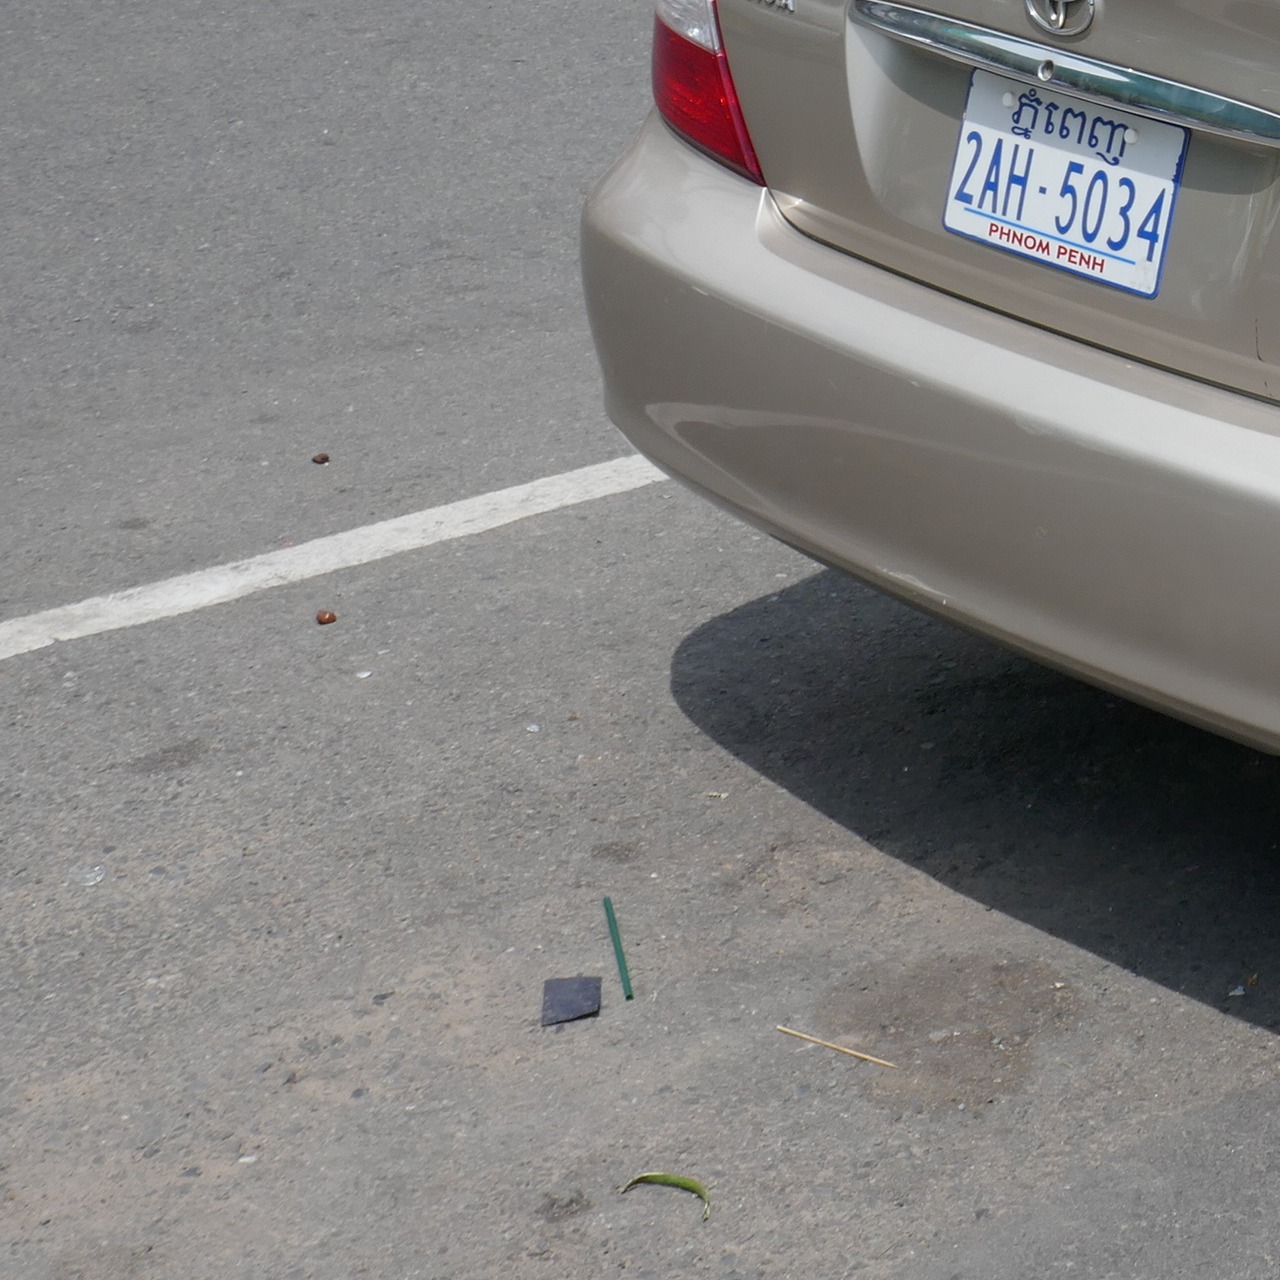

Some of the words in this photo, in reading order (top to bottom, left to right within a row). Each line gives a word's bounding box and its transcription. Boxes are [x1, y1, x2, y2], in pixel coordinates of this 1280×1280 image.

[1012, 88, 1129, 166] ភ្នំពេញ
[954, 130, 1166, 263] 2AH-5034
[988, 222, 1051, 257] PHNOM
[1056, 250, 1106, 274] PENH
